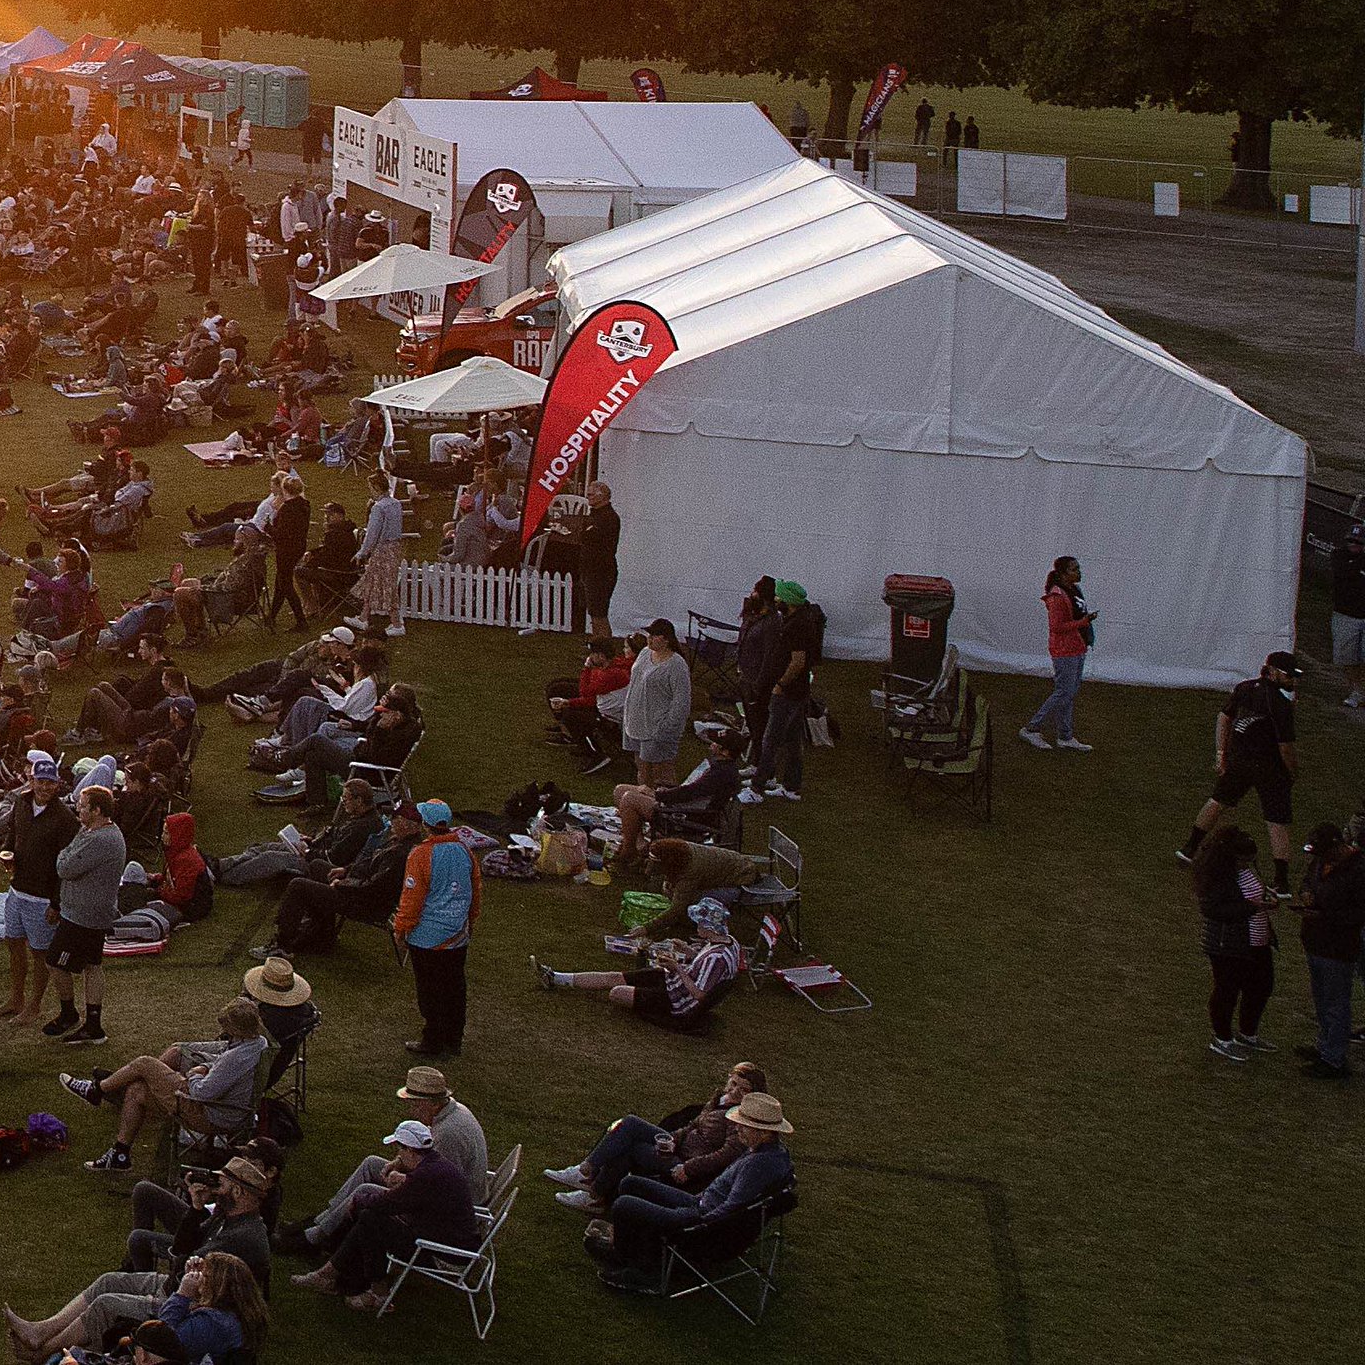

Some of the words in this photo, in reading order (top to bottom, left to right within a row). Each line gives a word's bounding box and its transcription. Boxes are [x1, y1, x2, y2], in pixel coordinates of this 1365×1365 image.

[864, 79, 894, 125] MAGICIANS
[339, 121, 366, 149] EAGLE
[375, 134, 400, 180] BAR
[414, 145, 448, 177] EAGLE
[599, 334, 651, 354] CANTERBURY
[538, 368, 640, 493] HOSPITALITY
